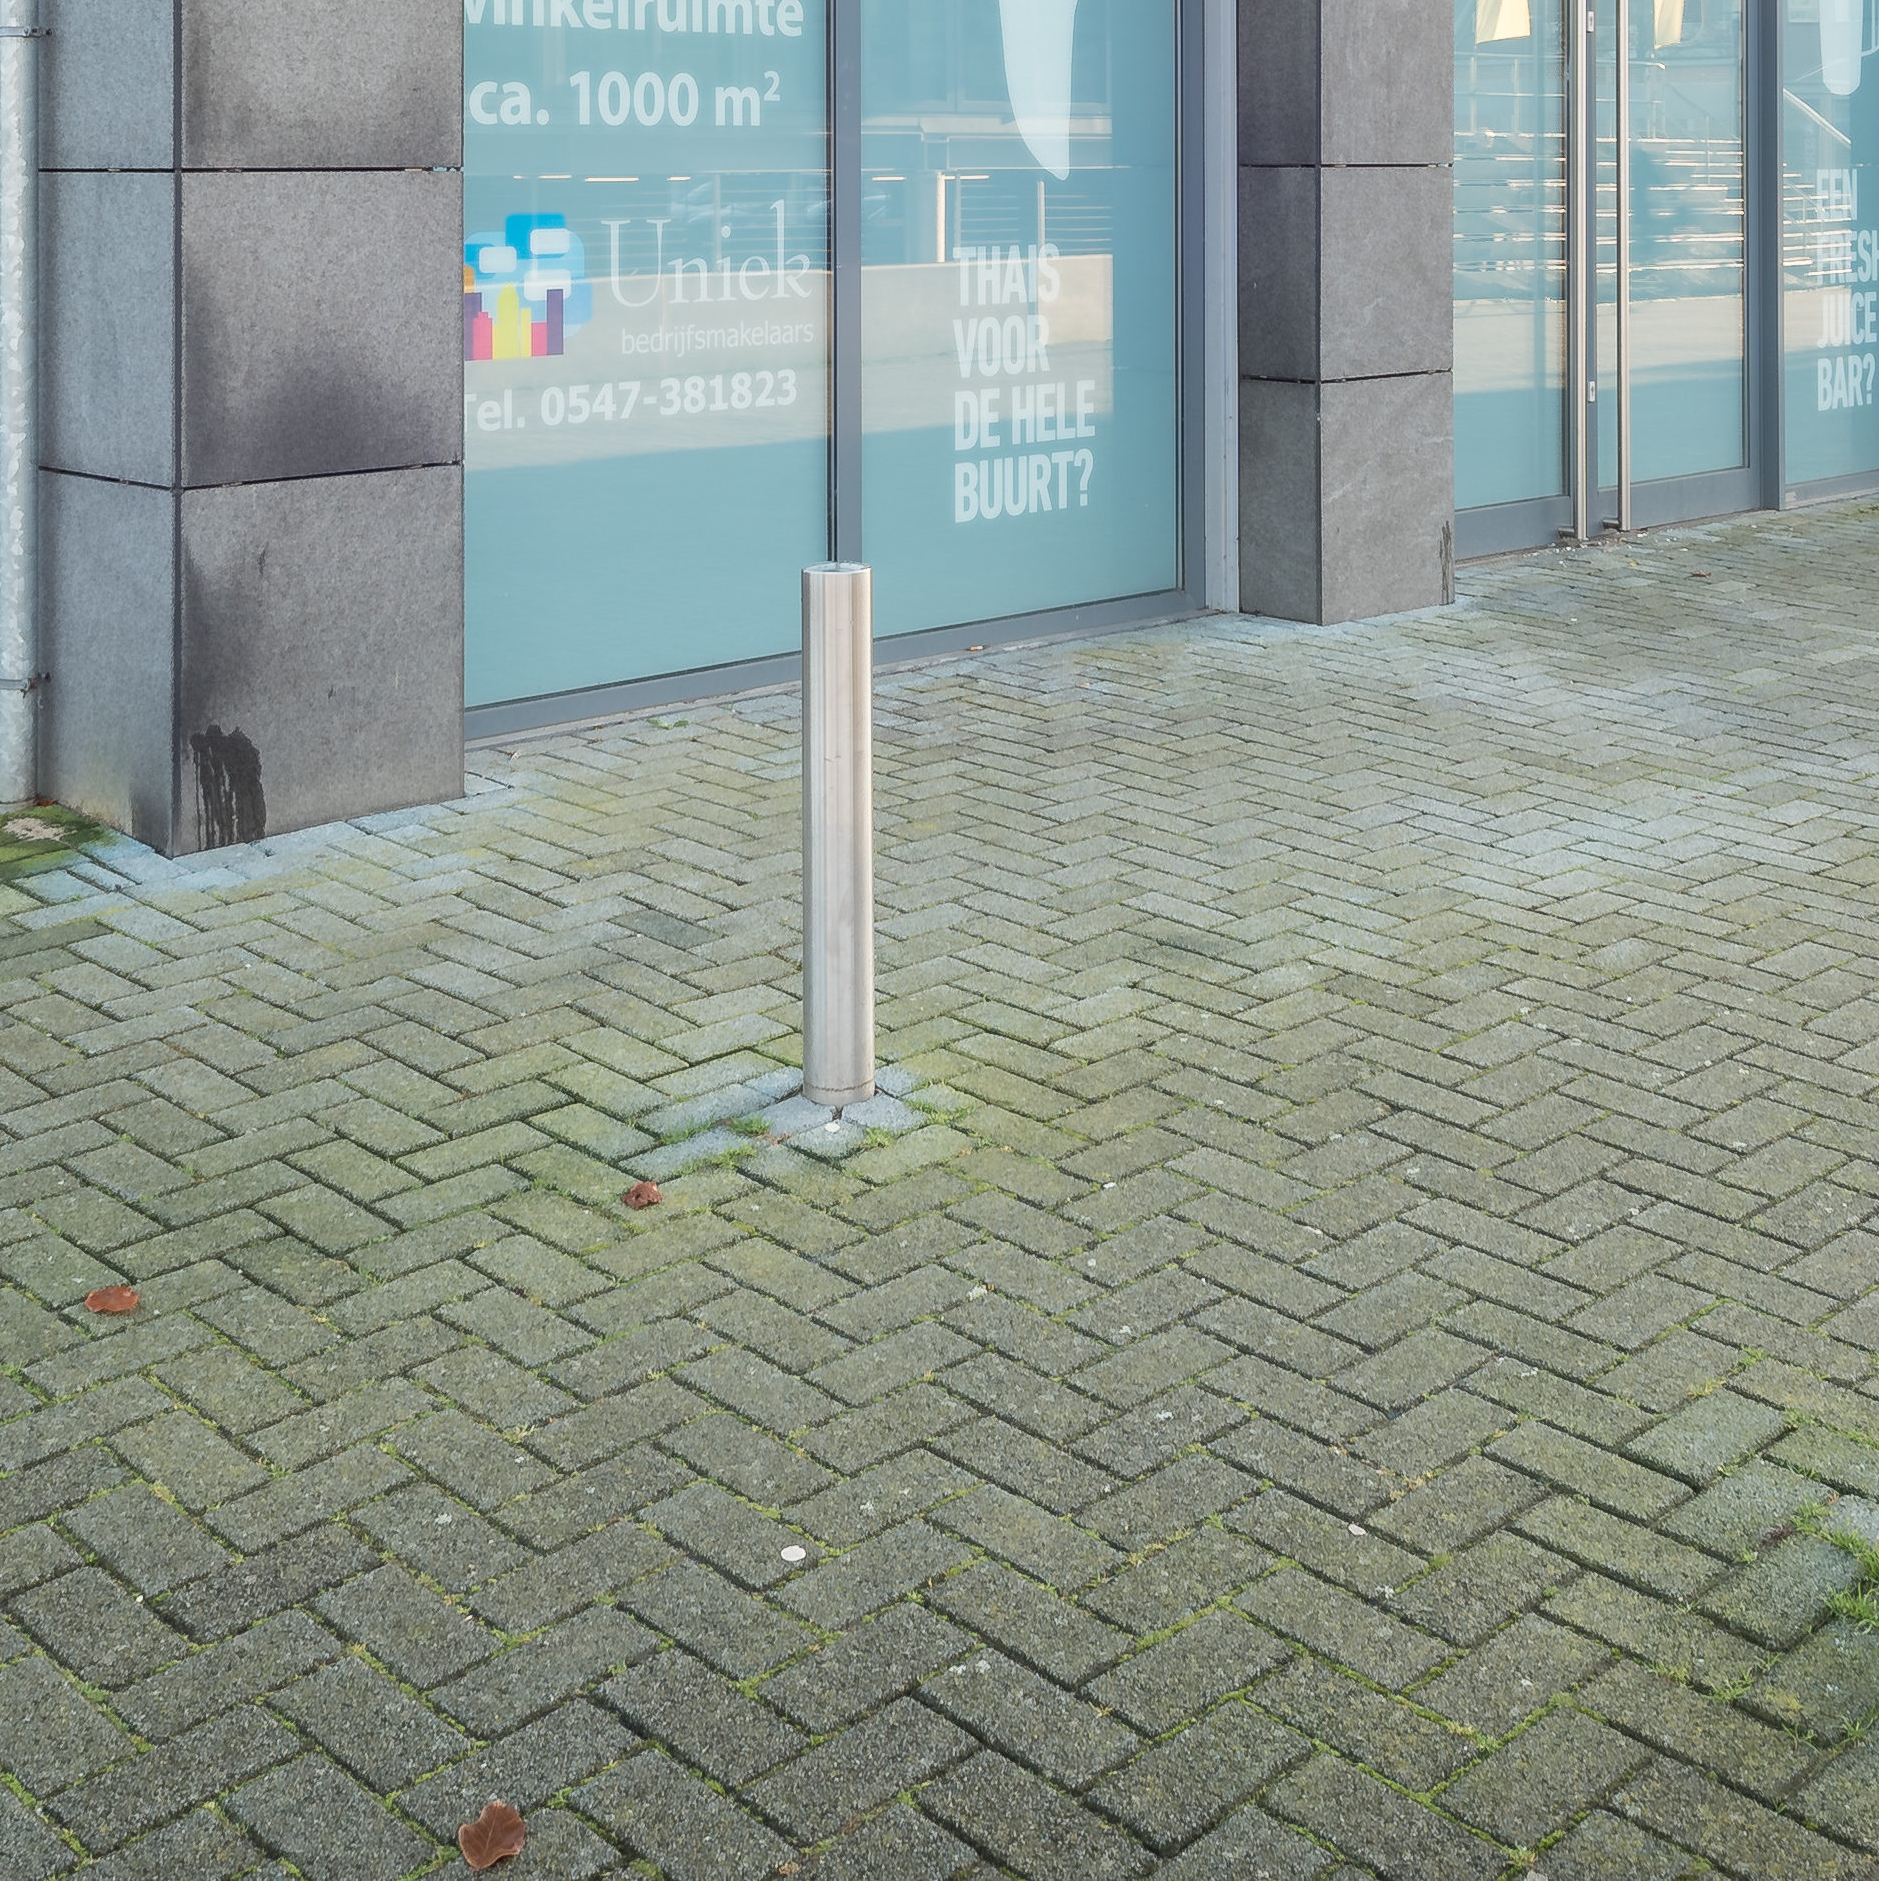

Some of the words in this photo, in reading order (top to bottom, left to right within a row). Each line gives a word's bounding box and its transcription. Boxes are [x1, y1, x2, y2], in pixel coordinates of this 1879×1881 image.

[468, 81, 551, 126] ca.
[569, 71, 700, 127] 1000
[1816, 169, 1858, 220] EEN
[600, 199, 813, 307] Uniek
[952, 243, 1061, 307] THAIS
[621, 320, 815, 357] bedrijfsmakelaars
[952, 315, 1051, 378] VOOR
[1816, 291, 1878, 349] JUICE
[540, 368, 798, 427] 0547-381823
[1817, 353, 1876, 412] BAR?
[954, 387, 1001, 451] DE
[1011, 379, 1096, 445] HELE
[954, 448, 1094, 524] BUURT?
